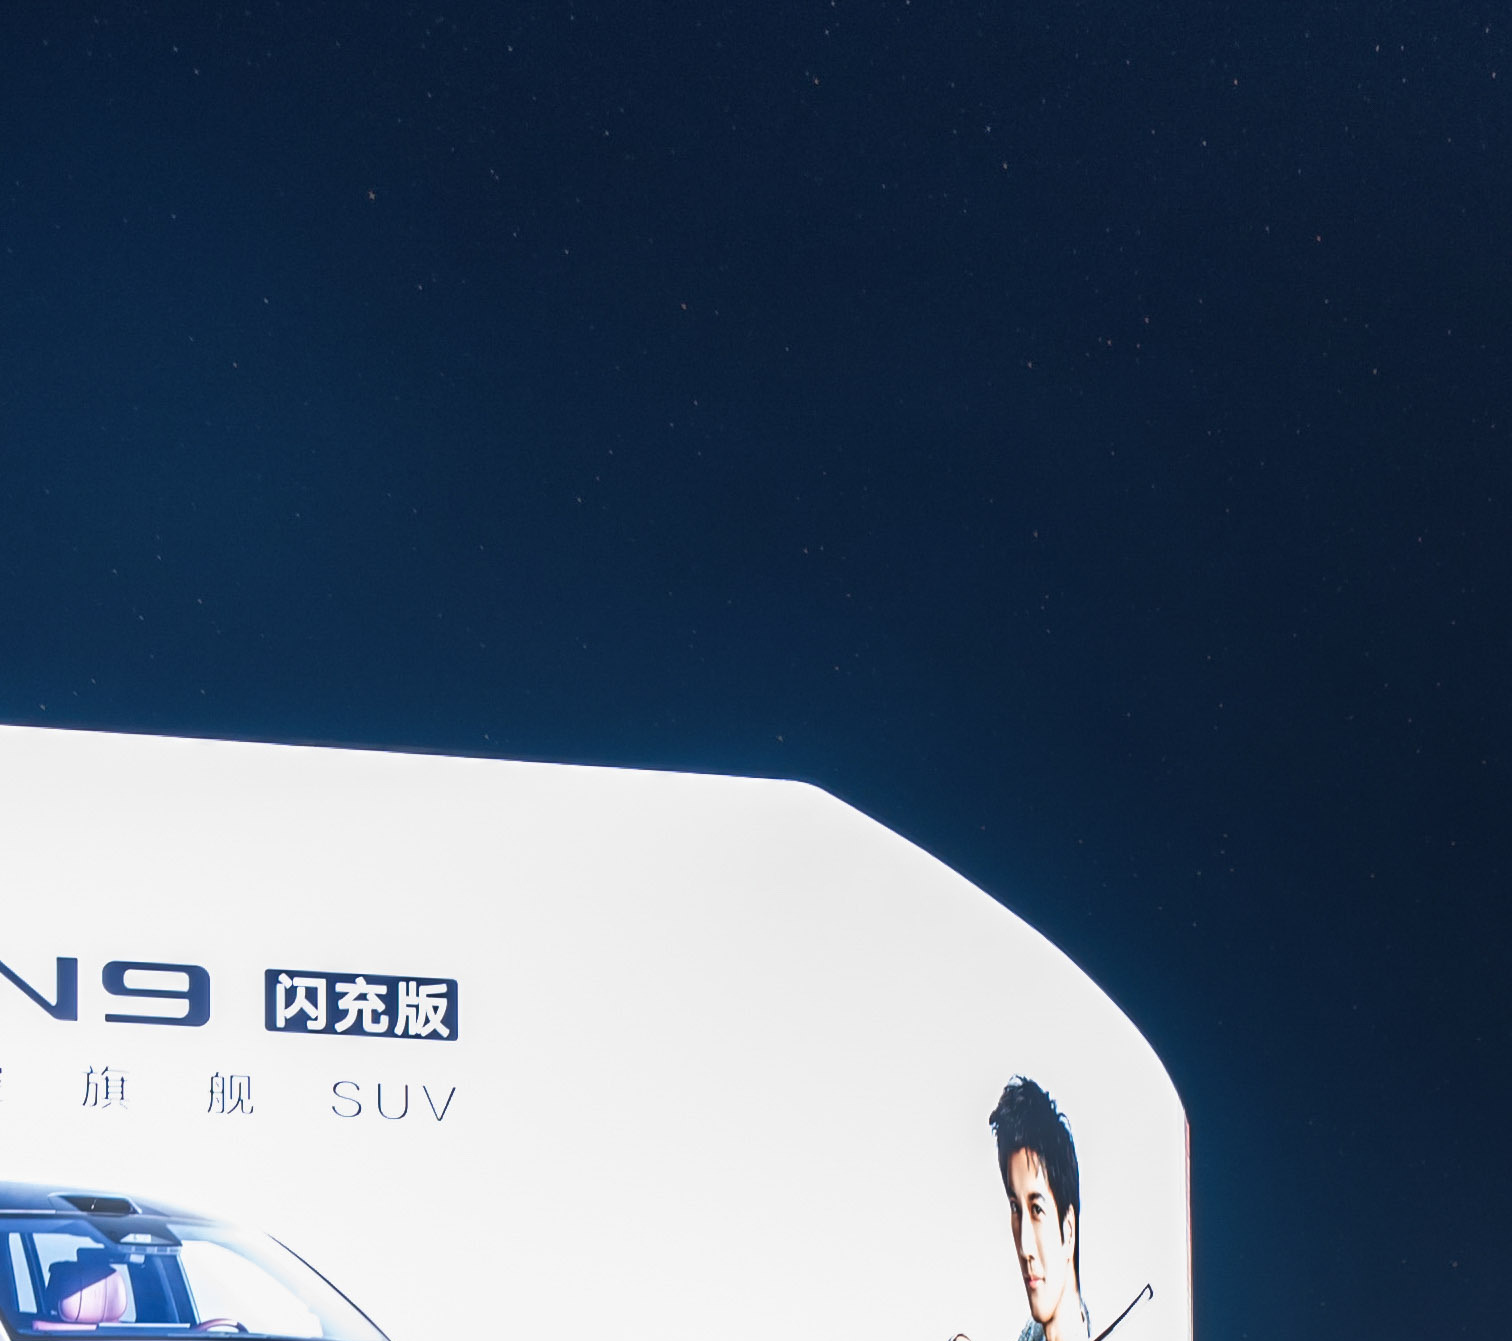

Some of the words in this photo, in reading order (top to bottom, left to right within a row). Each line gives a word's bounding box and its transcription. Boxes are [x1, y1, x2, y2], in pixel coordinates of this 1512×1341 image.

[272, 975, 452, 1038] 闪充版
[330, 1079, 460, 1124] SUV
